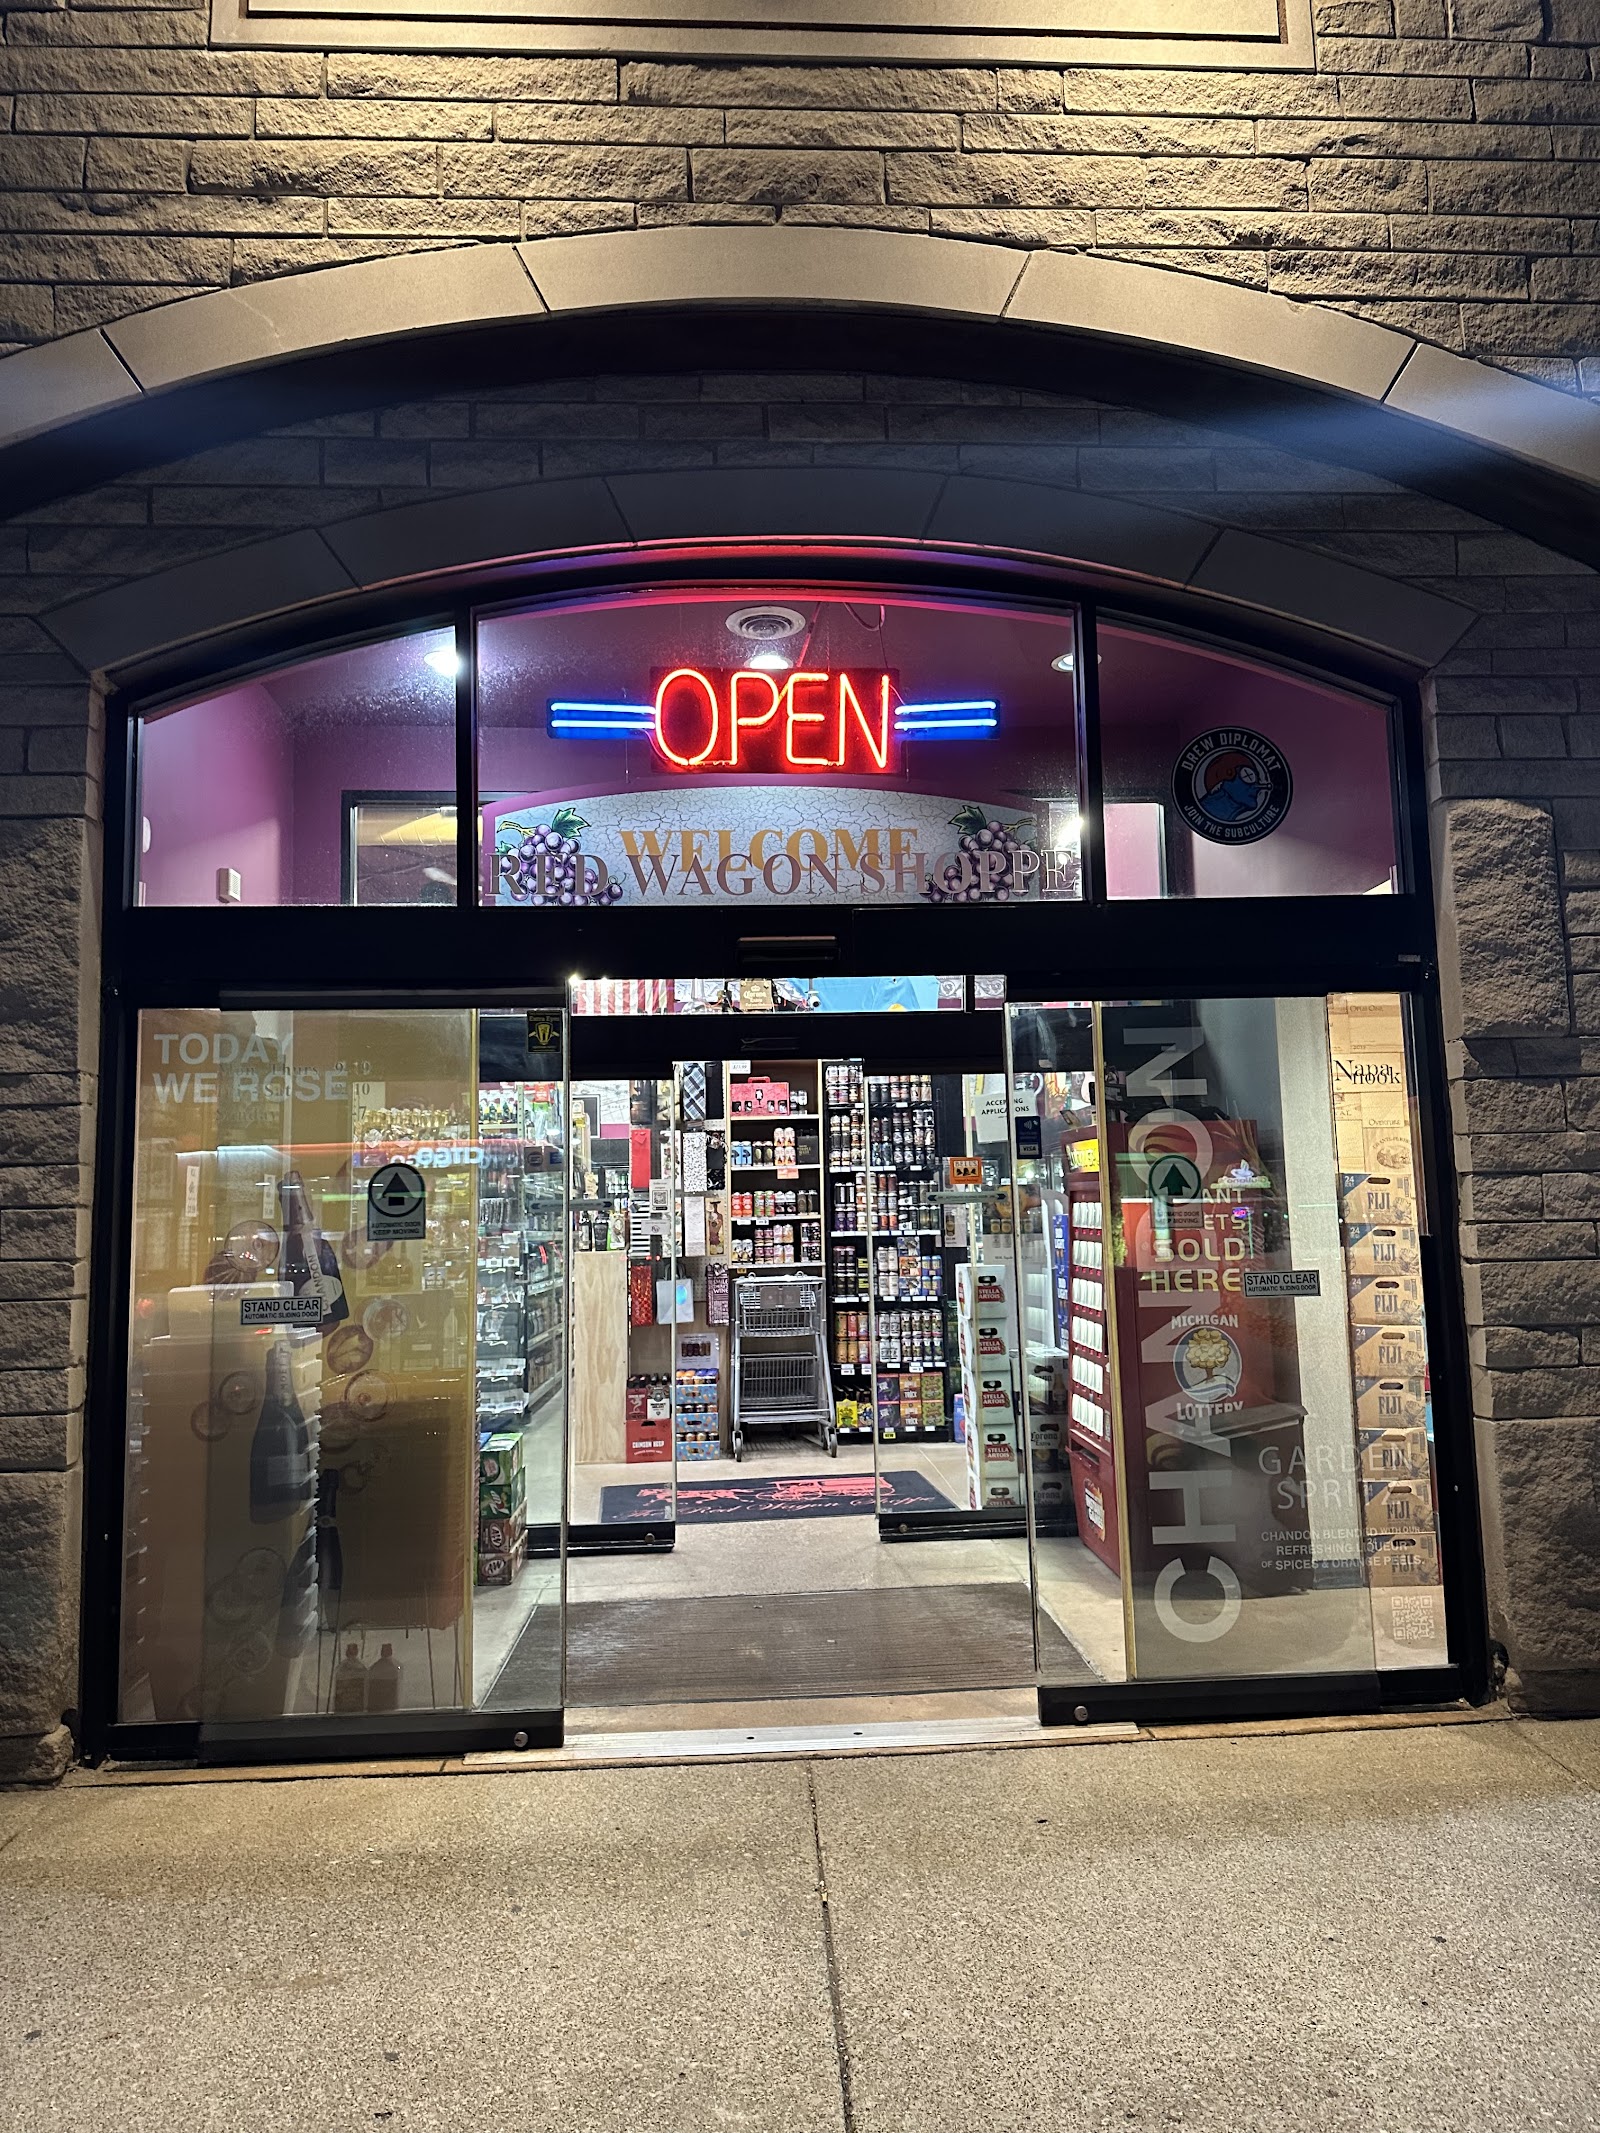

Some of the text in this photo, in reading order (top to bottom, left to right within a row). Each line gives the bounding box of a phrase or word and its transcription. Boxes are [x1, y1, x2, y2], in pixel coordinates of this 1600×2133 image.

[654, 667, 890, 769] OPEN
[1181, 732, 1281, 771] DREW DIPLOMAT
[1184, 804, 1279, 838] JOIN THE SUBCULTURE
[620, 828, 918, 872] WELCOME
[485, 849, 1077, 896] RED WAGON SHOPPE
[153, 1033, 293, 1065] TODAY
[1333, 1059, 1391, 1082] Napa
[1352, 1066, 1402, 1085] nook
[152, 1072, 218, 1104] WE
[981, 1106, 1030, 1115] APPLICAONS
[986, 1098, 1023, 1106] ACCEPNG
[1366, 1192, 1390, 1210] FIJI
[1350, 1226, 1361, 1234] 24
[1155, 1237, 1246, 1262] SOLD
[1373, 1243, 1396, 1262] FIJI
[1151, 1268, 1249, 1293] HERE
[1246, 1273, 1316, 1286] STAND CLEAR
[1352, 1277, 1362, 1285] 24
[244, 1300, 319, 1312] STAND CLEAR
[1374, 1294, 1398, 1313] FIJI
[1171, 1314, 1239, 1330] MICHIGAN
[1356, 1328, 1366, 1336] 24
[1378, 1346, 1402, 1364] FIJI
[1355, 1379, 1366, 1387] 24
[1378, 1396, 1402, 1415] FIJI
[1359, 1432, 1370, 1440] 24
[1258, 1443, 1412, 1475] GARDEN
[1261, 1530, 1320, 1542] CHANDON
[1323, 1527, 1377, 1540] BLENDED
[1276, 1541, 1408, 1556] REFRESHING LIQUEUR
[1275, 1559, 1319, 1571] SPICES
[1321, 1559, 1329, 1568] &
[1331, 1557, 1380, 1569] ORANGE
[1384, 1555, 1425, 1566] PEELS.
